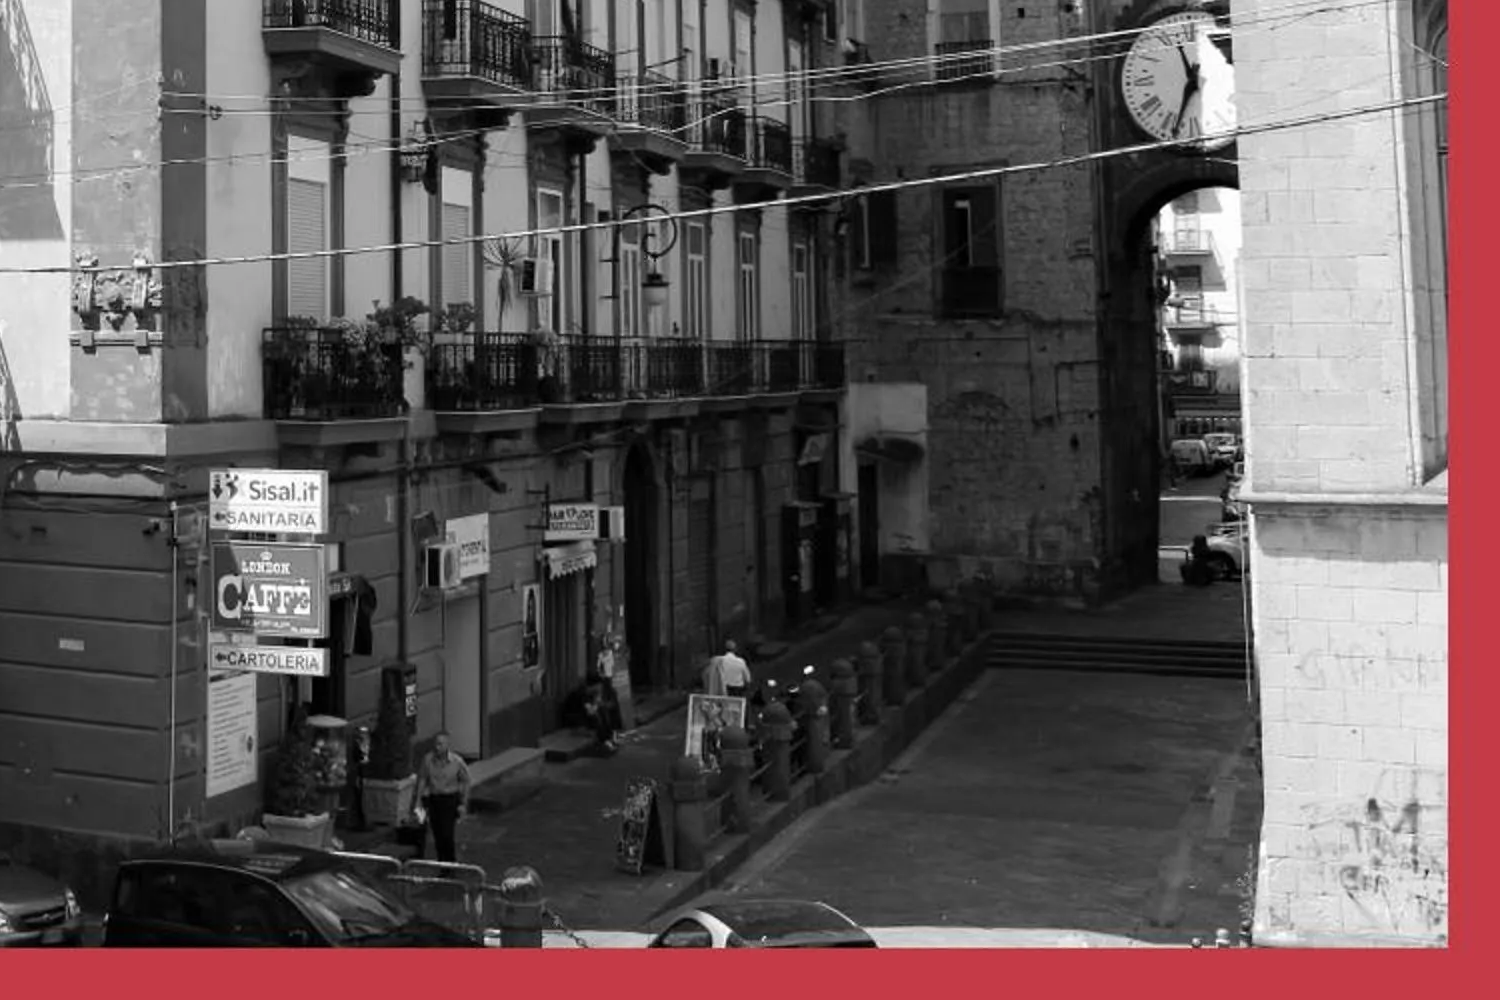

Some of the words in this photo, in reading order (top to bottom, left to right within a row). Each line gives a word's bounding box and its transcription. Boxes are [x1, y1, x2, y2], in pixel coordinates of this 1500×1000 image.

[249, 479, 319, 502] Sisal.it
[226, 511, 317, 527] SANITARIA
[241, 561, 291, 576] LONDON
[227, 651, 320, 671] CARTOLERIA
